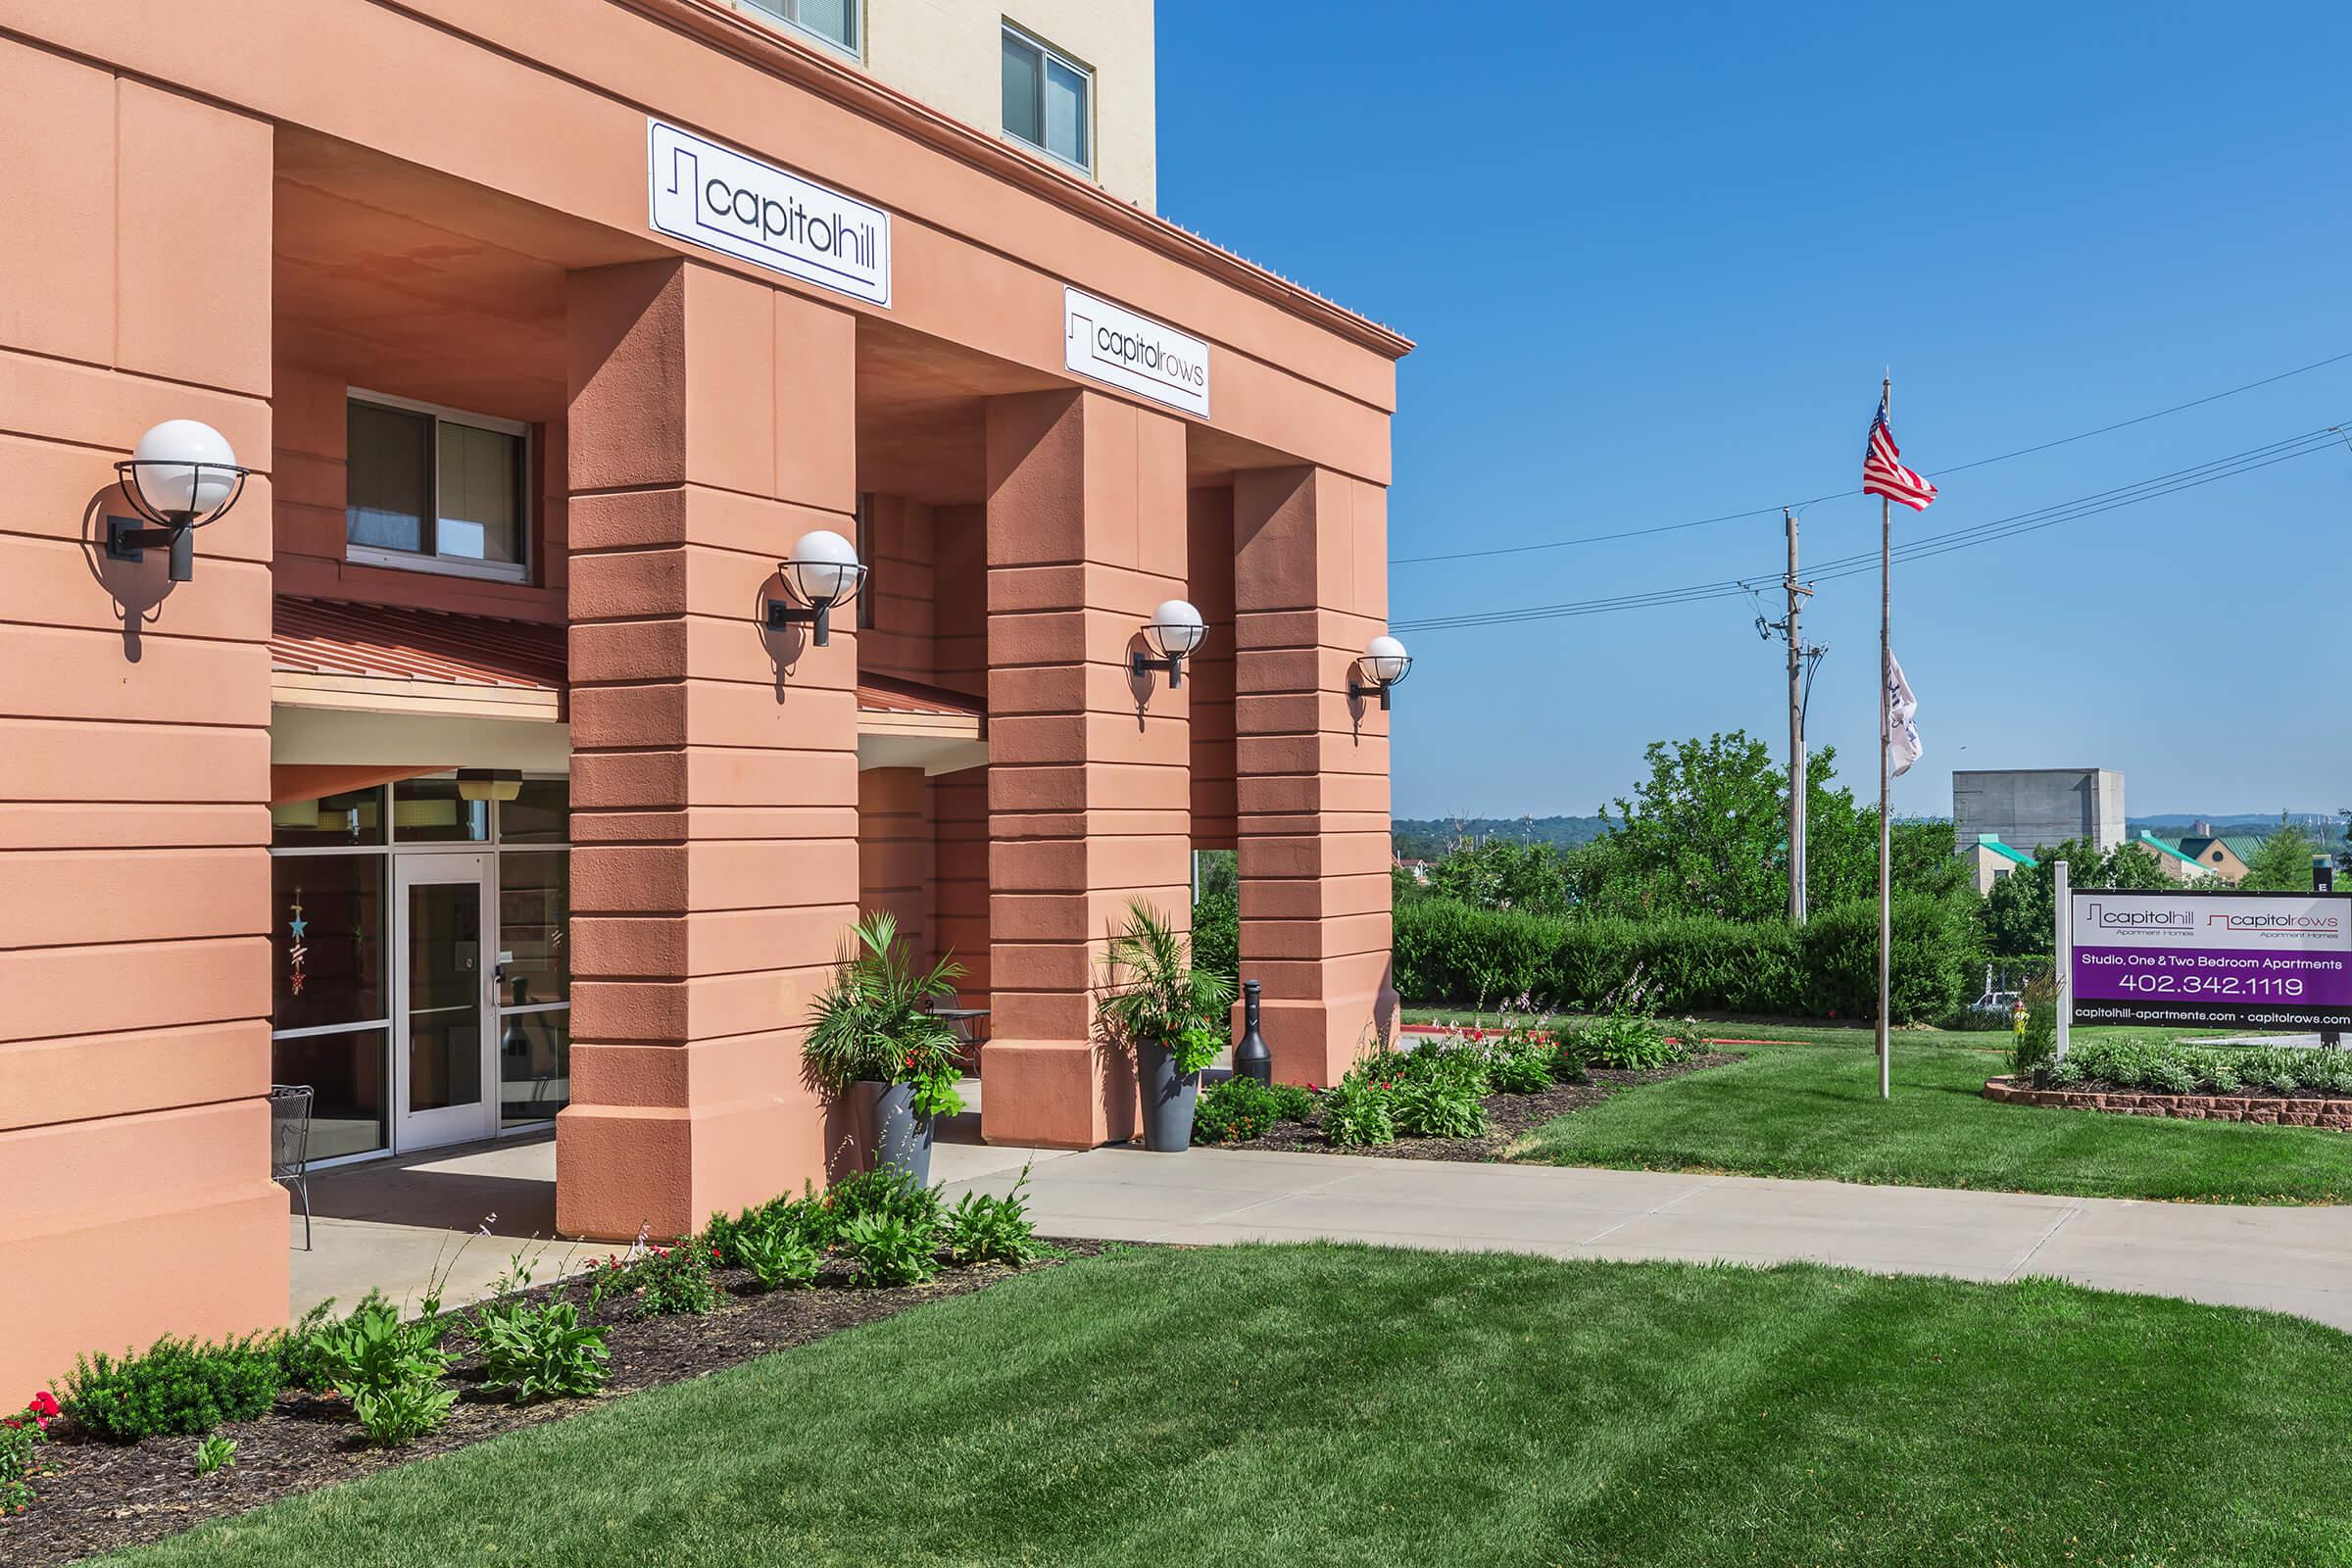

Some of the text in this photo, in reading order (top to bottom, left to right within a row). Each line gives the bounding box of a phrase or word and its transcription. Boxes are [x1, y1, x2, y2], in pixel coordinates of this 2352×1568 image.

[705, 177, 875, 270] capitolhill
[1098, 326, 1204, 386] capitolrows
[2103, 910, 2194, 926] capitolhill
[2230, 913, 2338, 928] capitolrows
[2082, 954, 2343, 970] Studio, One & Two Bedroom Apartments
[2119, 974, 2304, 996] 402.342.1119
[2075, 1007, 2351, 1024] capitolhill-apartments.com capitolrows.com
